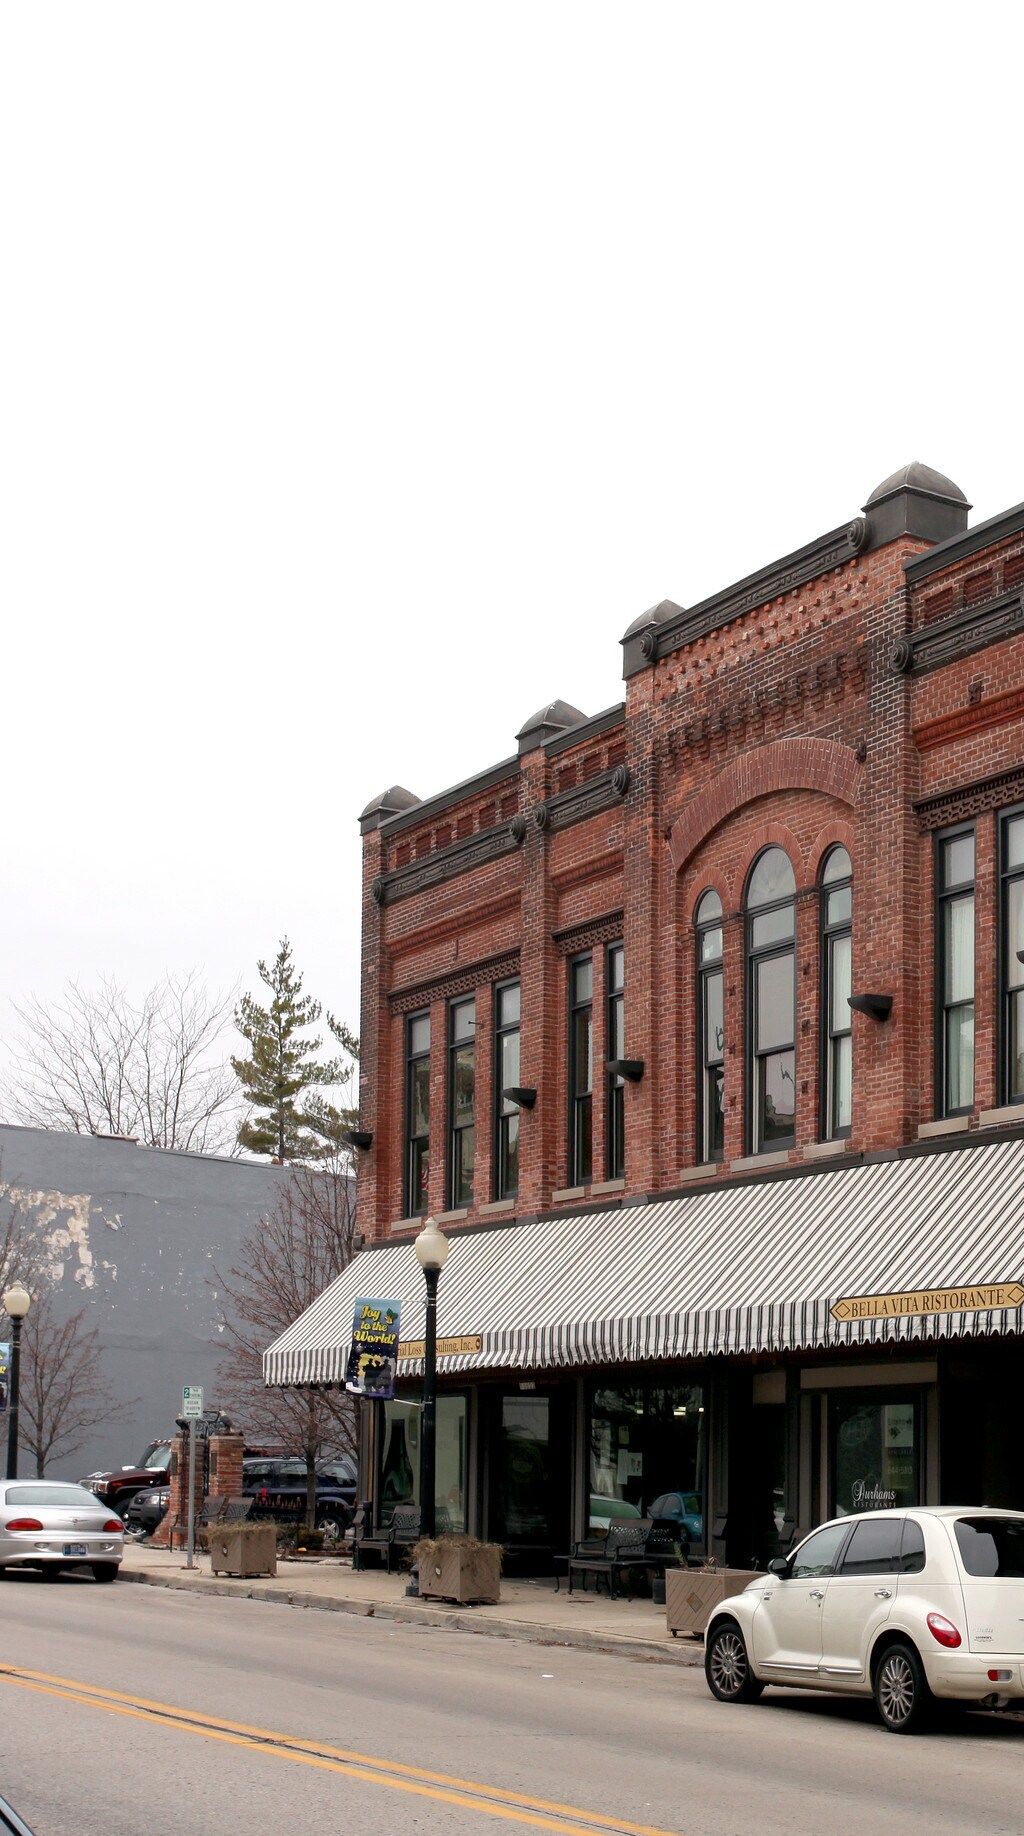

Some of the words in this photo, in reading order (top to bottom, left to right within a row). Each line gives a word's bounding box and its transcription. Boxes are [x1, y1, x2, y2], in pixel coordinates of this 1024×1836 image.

[851, 1300, 889, 1318] BELLA
[891, 1297, 919, 1313] VITA
[922, 1288, 1005, 1310] RISTORANTE
[360, 1305, 381, 1321] Joy
[361, 1321, 371, 1330] to
[372, 1322, 387, 1331] the
[354, 1331, 396, 1344] World!
[408, 1344, 422, 1355] Loss
[460, 1338, 474, 1351] Inc.
[184, 1388, 189, 1397] 2
[852, 1479, 897, 1502] Durhams
